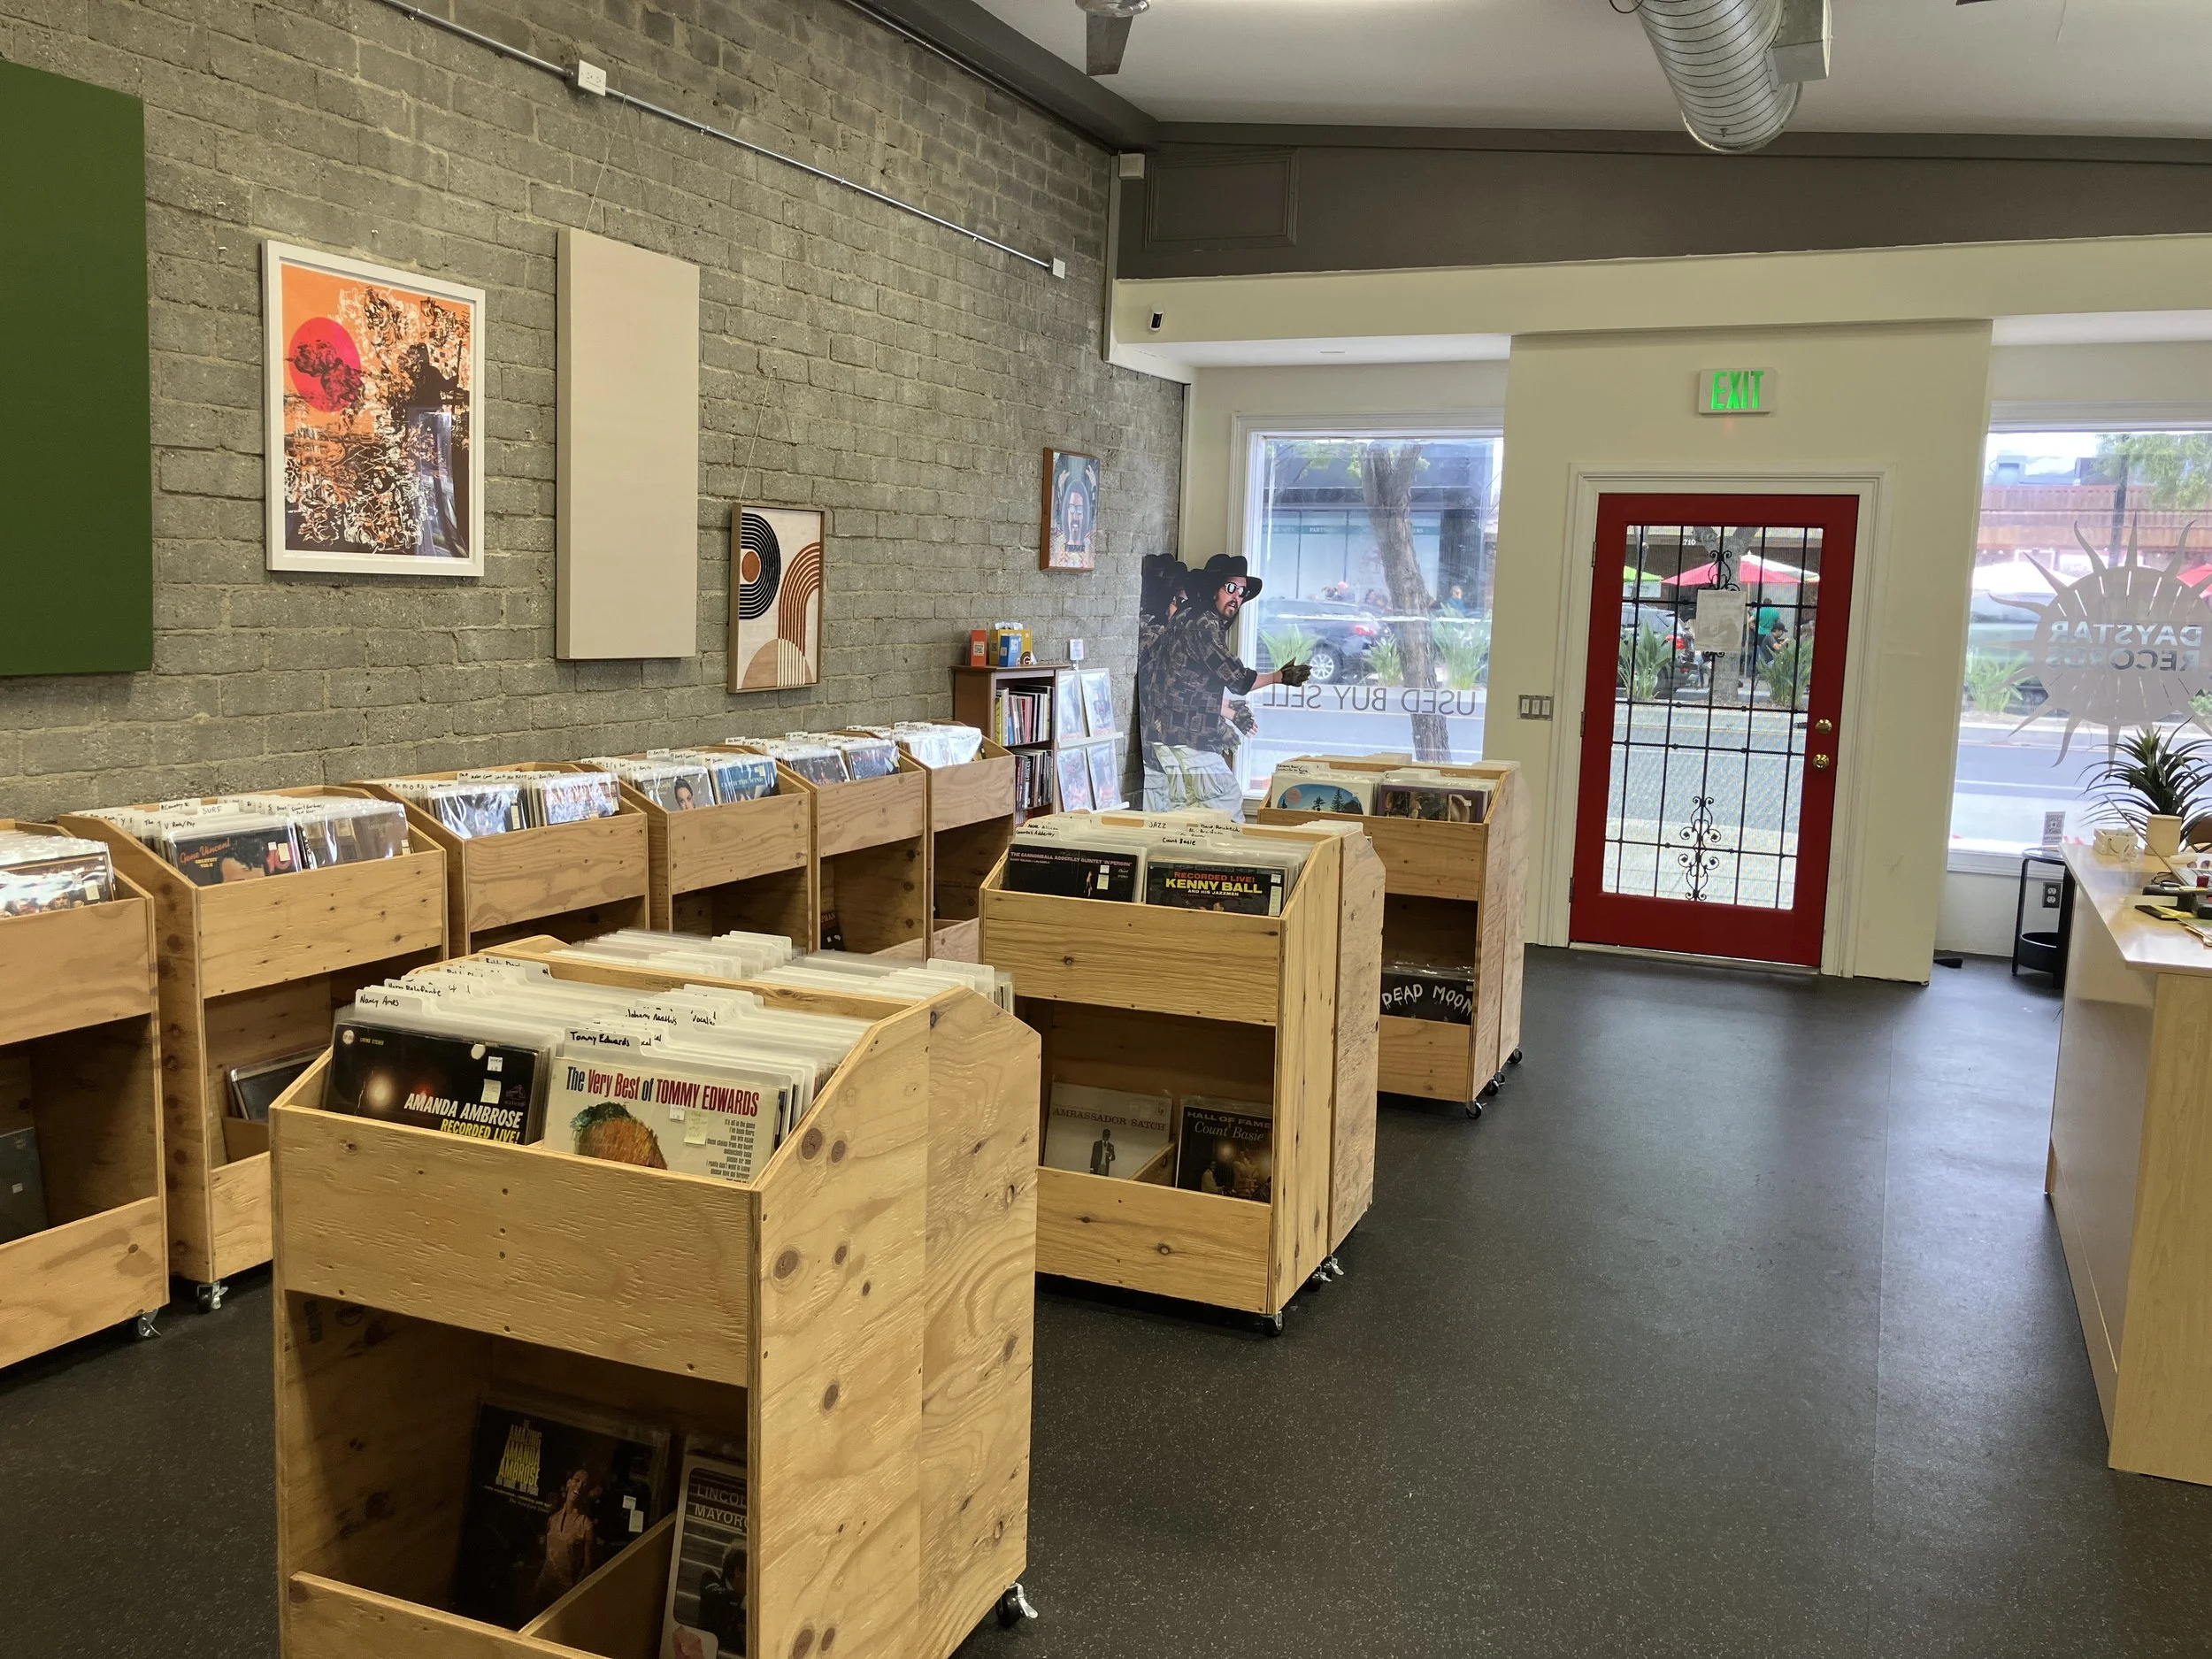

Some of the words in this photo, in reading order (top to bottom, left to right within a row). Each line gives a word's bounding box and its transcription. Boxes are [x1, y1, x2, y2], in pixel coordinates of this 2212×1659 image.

[1711, 370, 1764, 411] EXIT
[202, 805, 222, 815] SURF
[199, 837, 231, 856] Vincent
[1165, 878, 1219, 891] KENNY
[1221, 881, 1263, 894] BALL
[1174, 872, 1228, 881] RECORDED
[359, 994, 379, 1008] Nancy
[381, 995, 400, 1007] Ames
[1381, 983, 1424, 1010] DEAD
[1432, 985, 1474, 1017] MOON
[570, 1030, 597, 1046] Tommy
[598, 1033, 630, 1048] Edwards
[566, 1065, 586, 1093] The
[587, 1068, 613, 1098] Very
[614, 1072, 641, 1101] Best
[641, 1077, 656, 1102] of
[656, 1078, 702, 1110] TOMMY
[701, 1085, 760, 1118] EDWARDS
[403, 1093, 458, 1119] AMANDA
[459, 1102, 524, 1129] AMBROSE
[1052, 1107, 1127, 1126] AMBASSADOR
[1131, 1118, 1167, 1132] SATCH
[1186, 1110, 1217, 1122] HALL
[1218, 1114, 1236, 1124] OF
[1238, 1118, 1272, 1130] FAME
[441, 1118, 492, 1141] RECORDED
[492, 1127, 521, 1145] LIVE!
[1194, 1119, 1230, 1138] Count
[1232, 1125, 1265, 1142] Basie
[510, 1424, 543, 1448] AMAZING
[504, 1438, 541, 1464] AMANDA
[497, 1457, 541, 1487] AMBROSE
